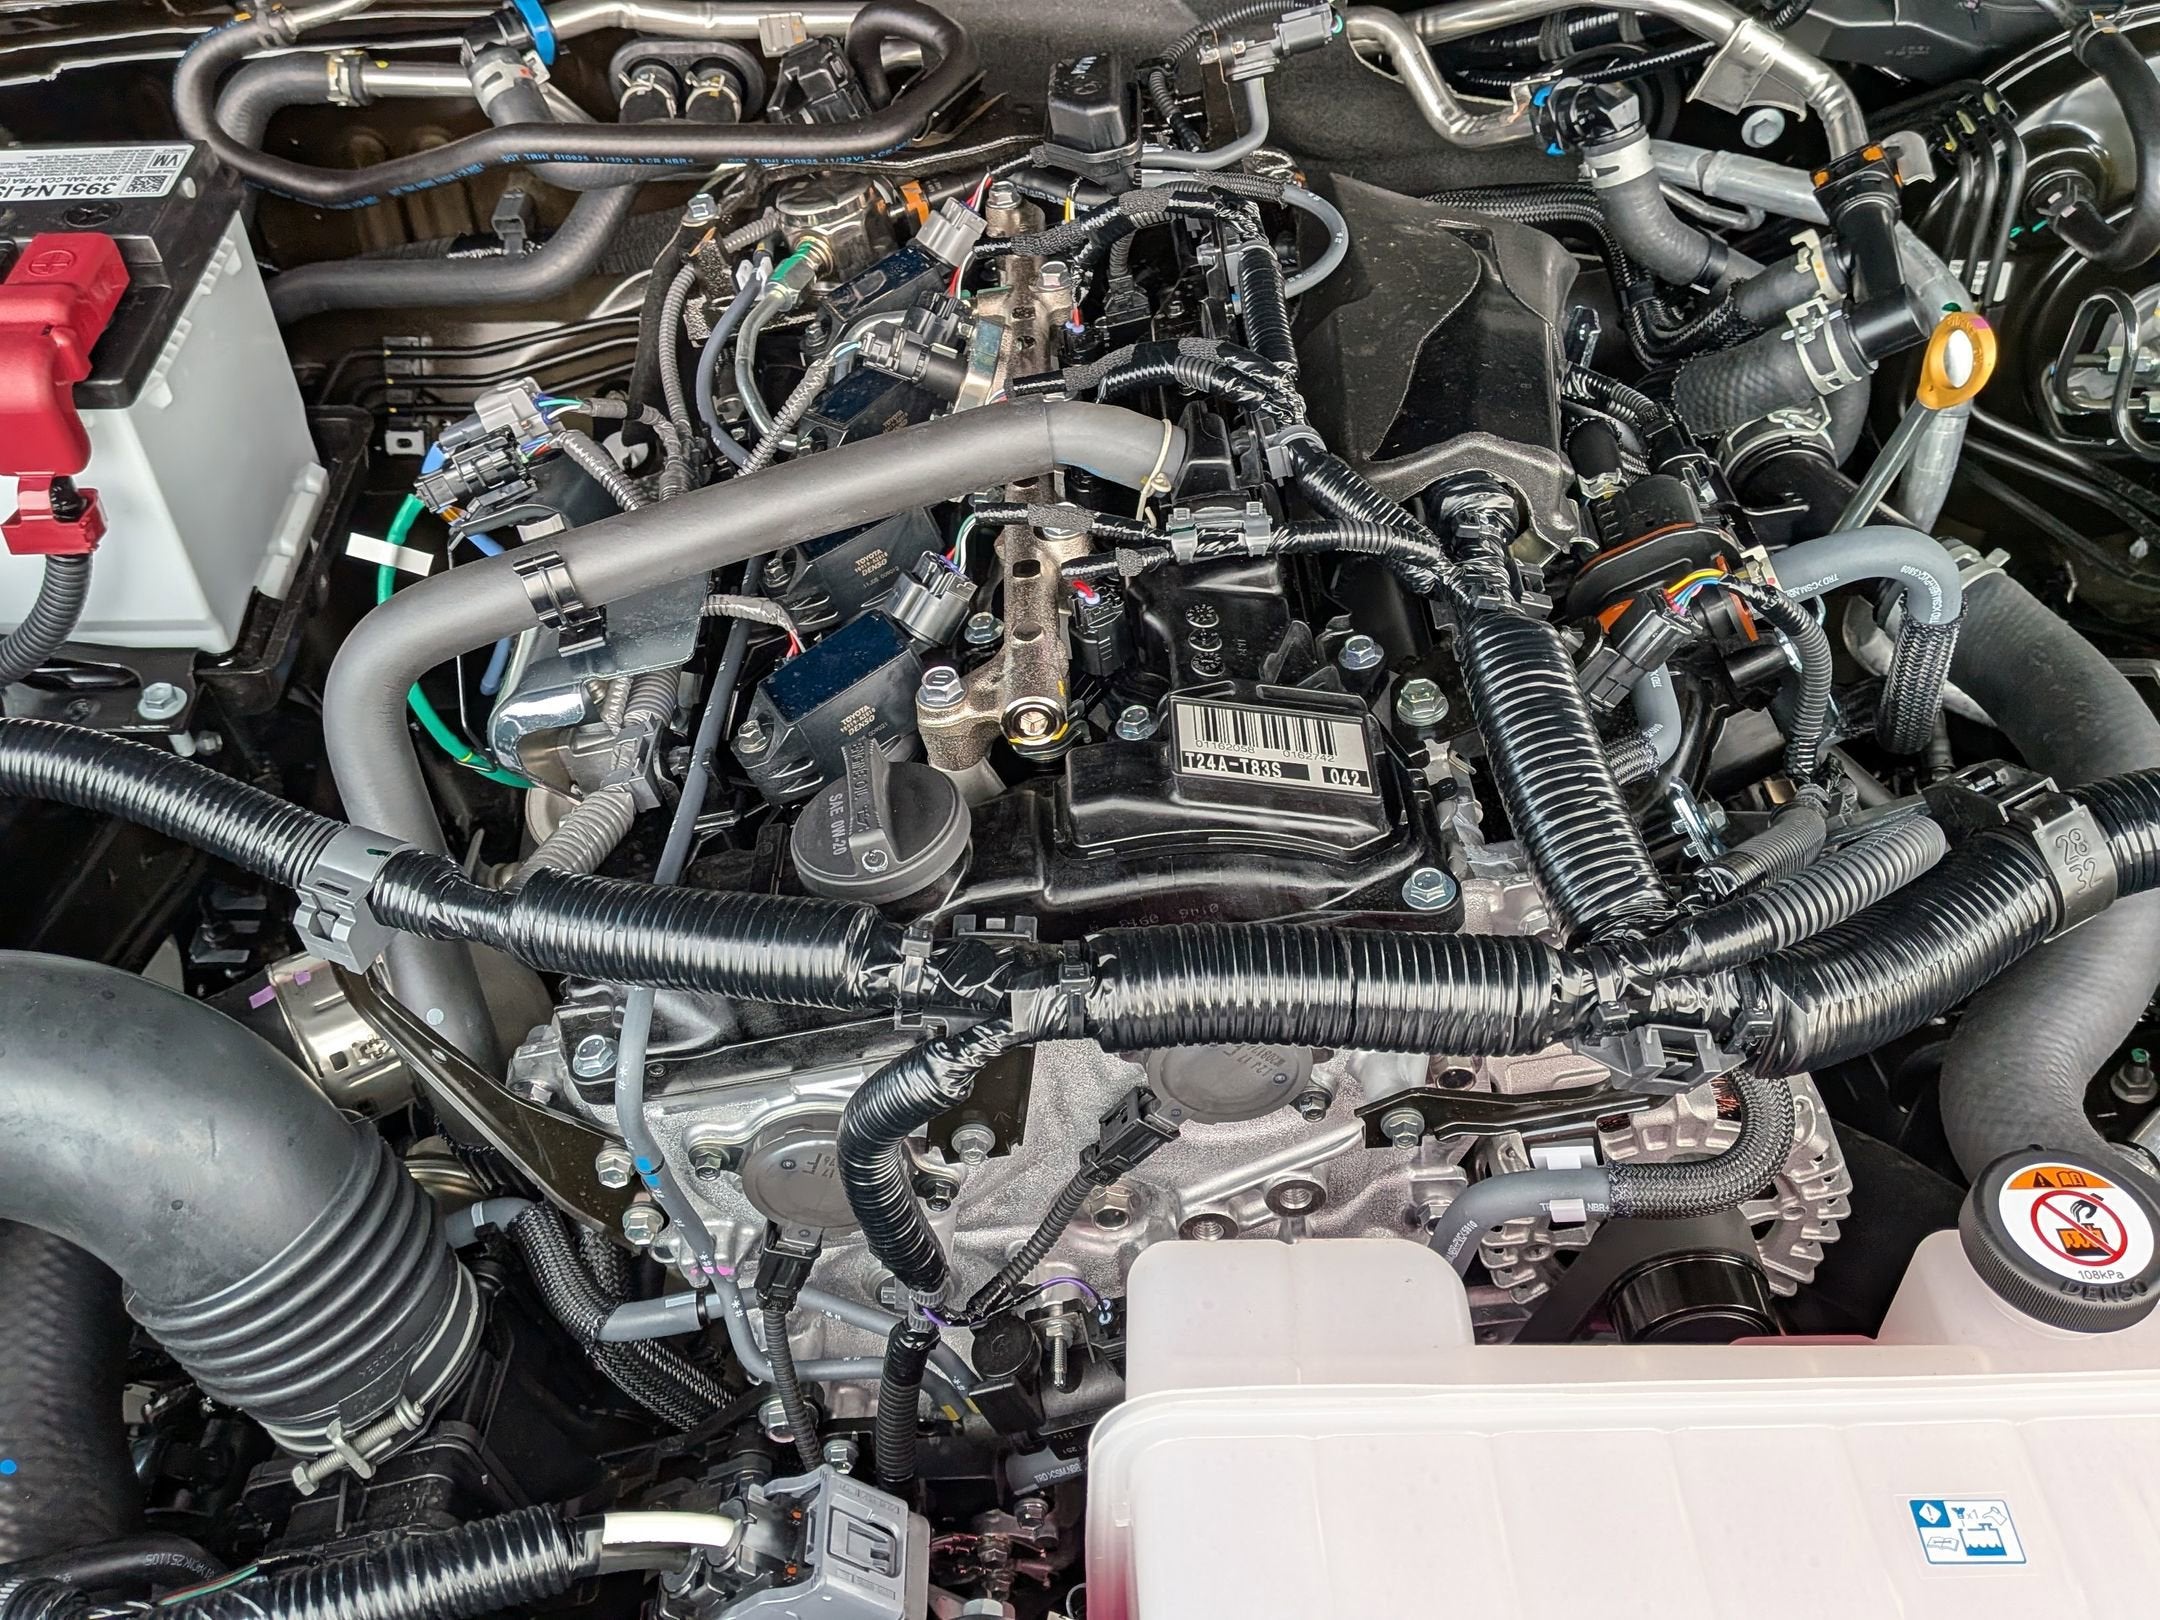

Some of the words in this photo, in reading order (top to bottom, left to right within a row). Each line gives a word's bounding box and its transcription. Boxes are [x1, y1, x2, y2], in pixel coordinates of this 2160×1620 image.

[152, 155, 178, 166] VM
[855, 549, 883, 566] TOYOTA
[861, 558, 888, 577] DENSO
[840, 705, 871, 726] TOYOTA
[847, 714, 876, 737] DENSO
[850, 742, 868, 780] ENGINE
[1195, 739, 1256, 755] 01162058
[1283, 749, 1336, 763] 0162742
[1185, 752, 1283, 778] T24A-T83S
[1330, 767, 1362, 787] 042
[829, 793, 844, 817] SAE
[830, 820, 848, 856] 0W-20
[2055, 827, 2089, 866] 28
[2069, 857, 2104, 896] 32
[2077, 1269, 2126, 1281] 108kPa
[2061, 1278, 2149, 1304] DENSO
